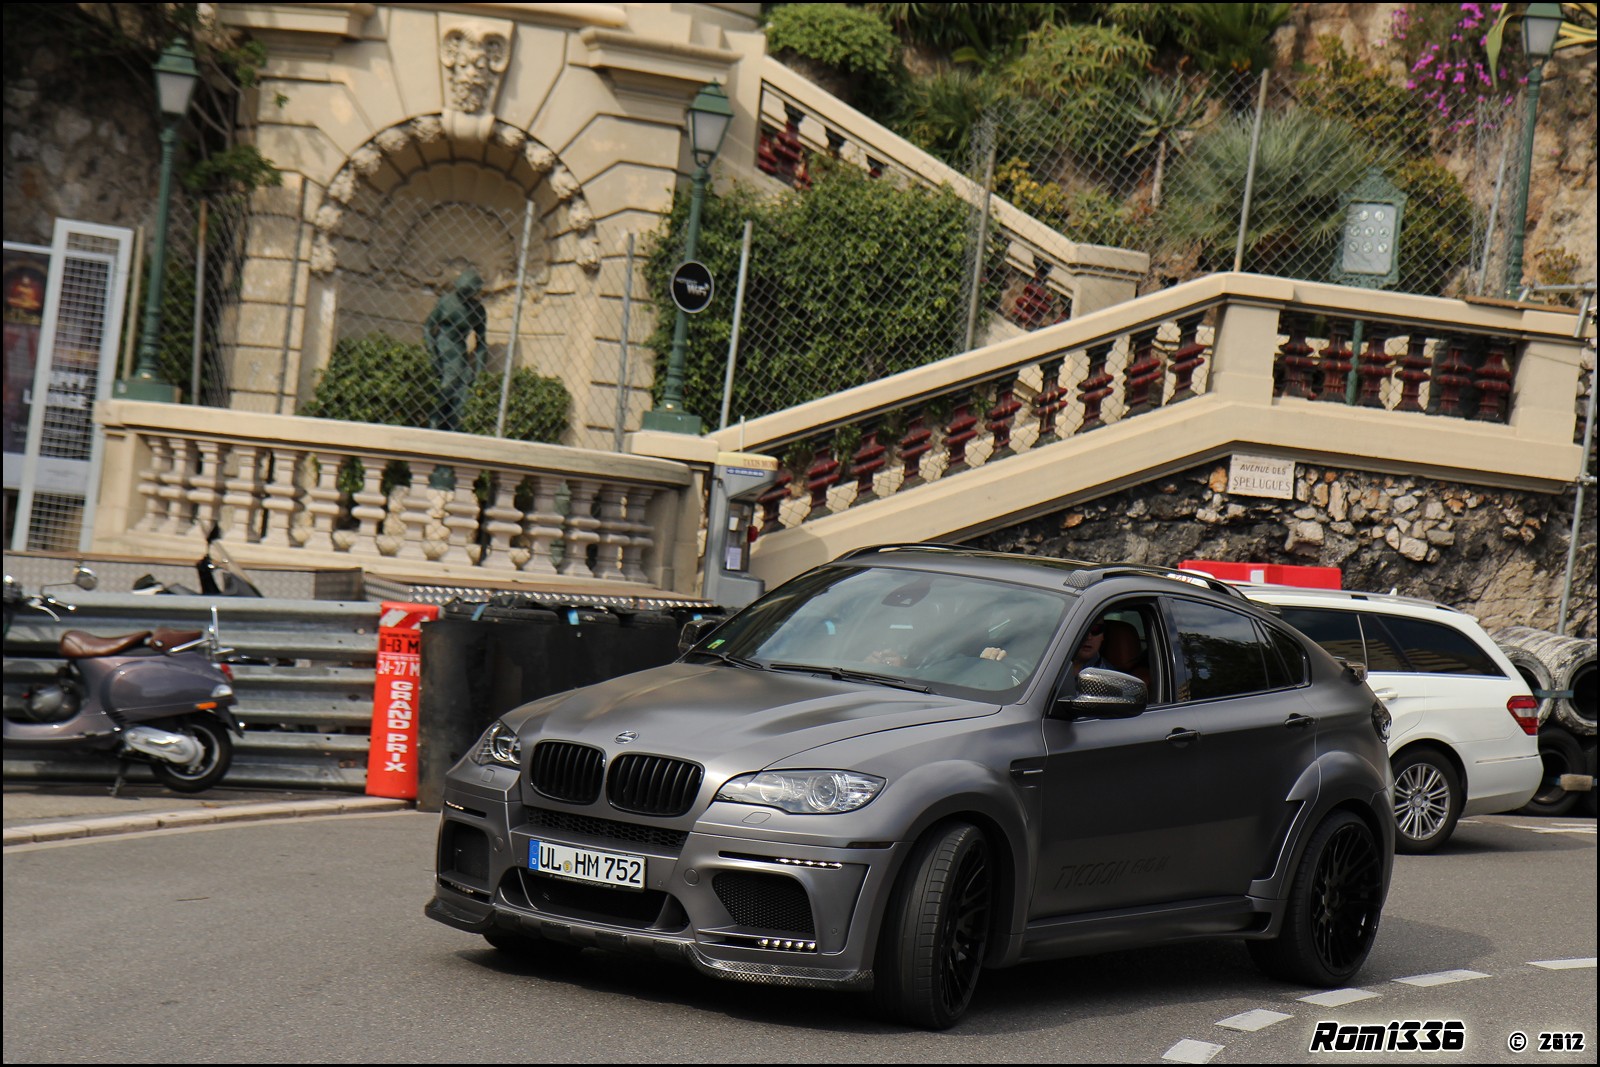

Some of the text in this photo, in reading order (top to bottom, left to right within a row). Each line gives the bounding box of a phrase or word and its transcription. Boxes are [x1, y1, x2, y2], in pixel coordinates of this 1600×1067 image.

[1233, 475, 1291, 492] SPELUGUES
[1240, 463, 1286, 475] AVENUE DES
[387, 680, 414, 730] GRAND
[384, 732, 409, 773] PRIX
[540, 845, 641, 884] UL HM 752
